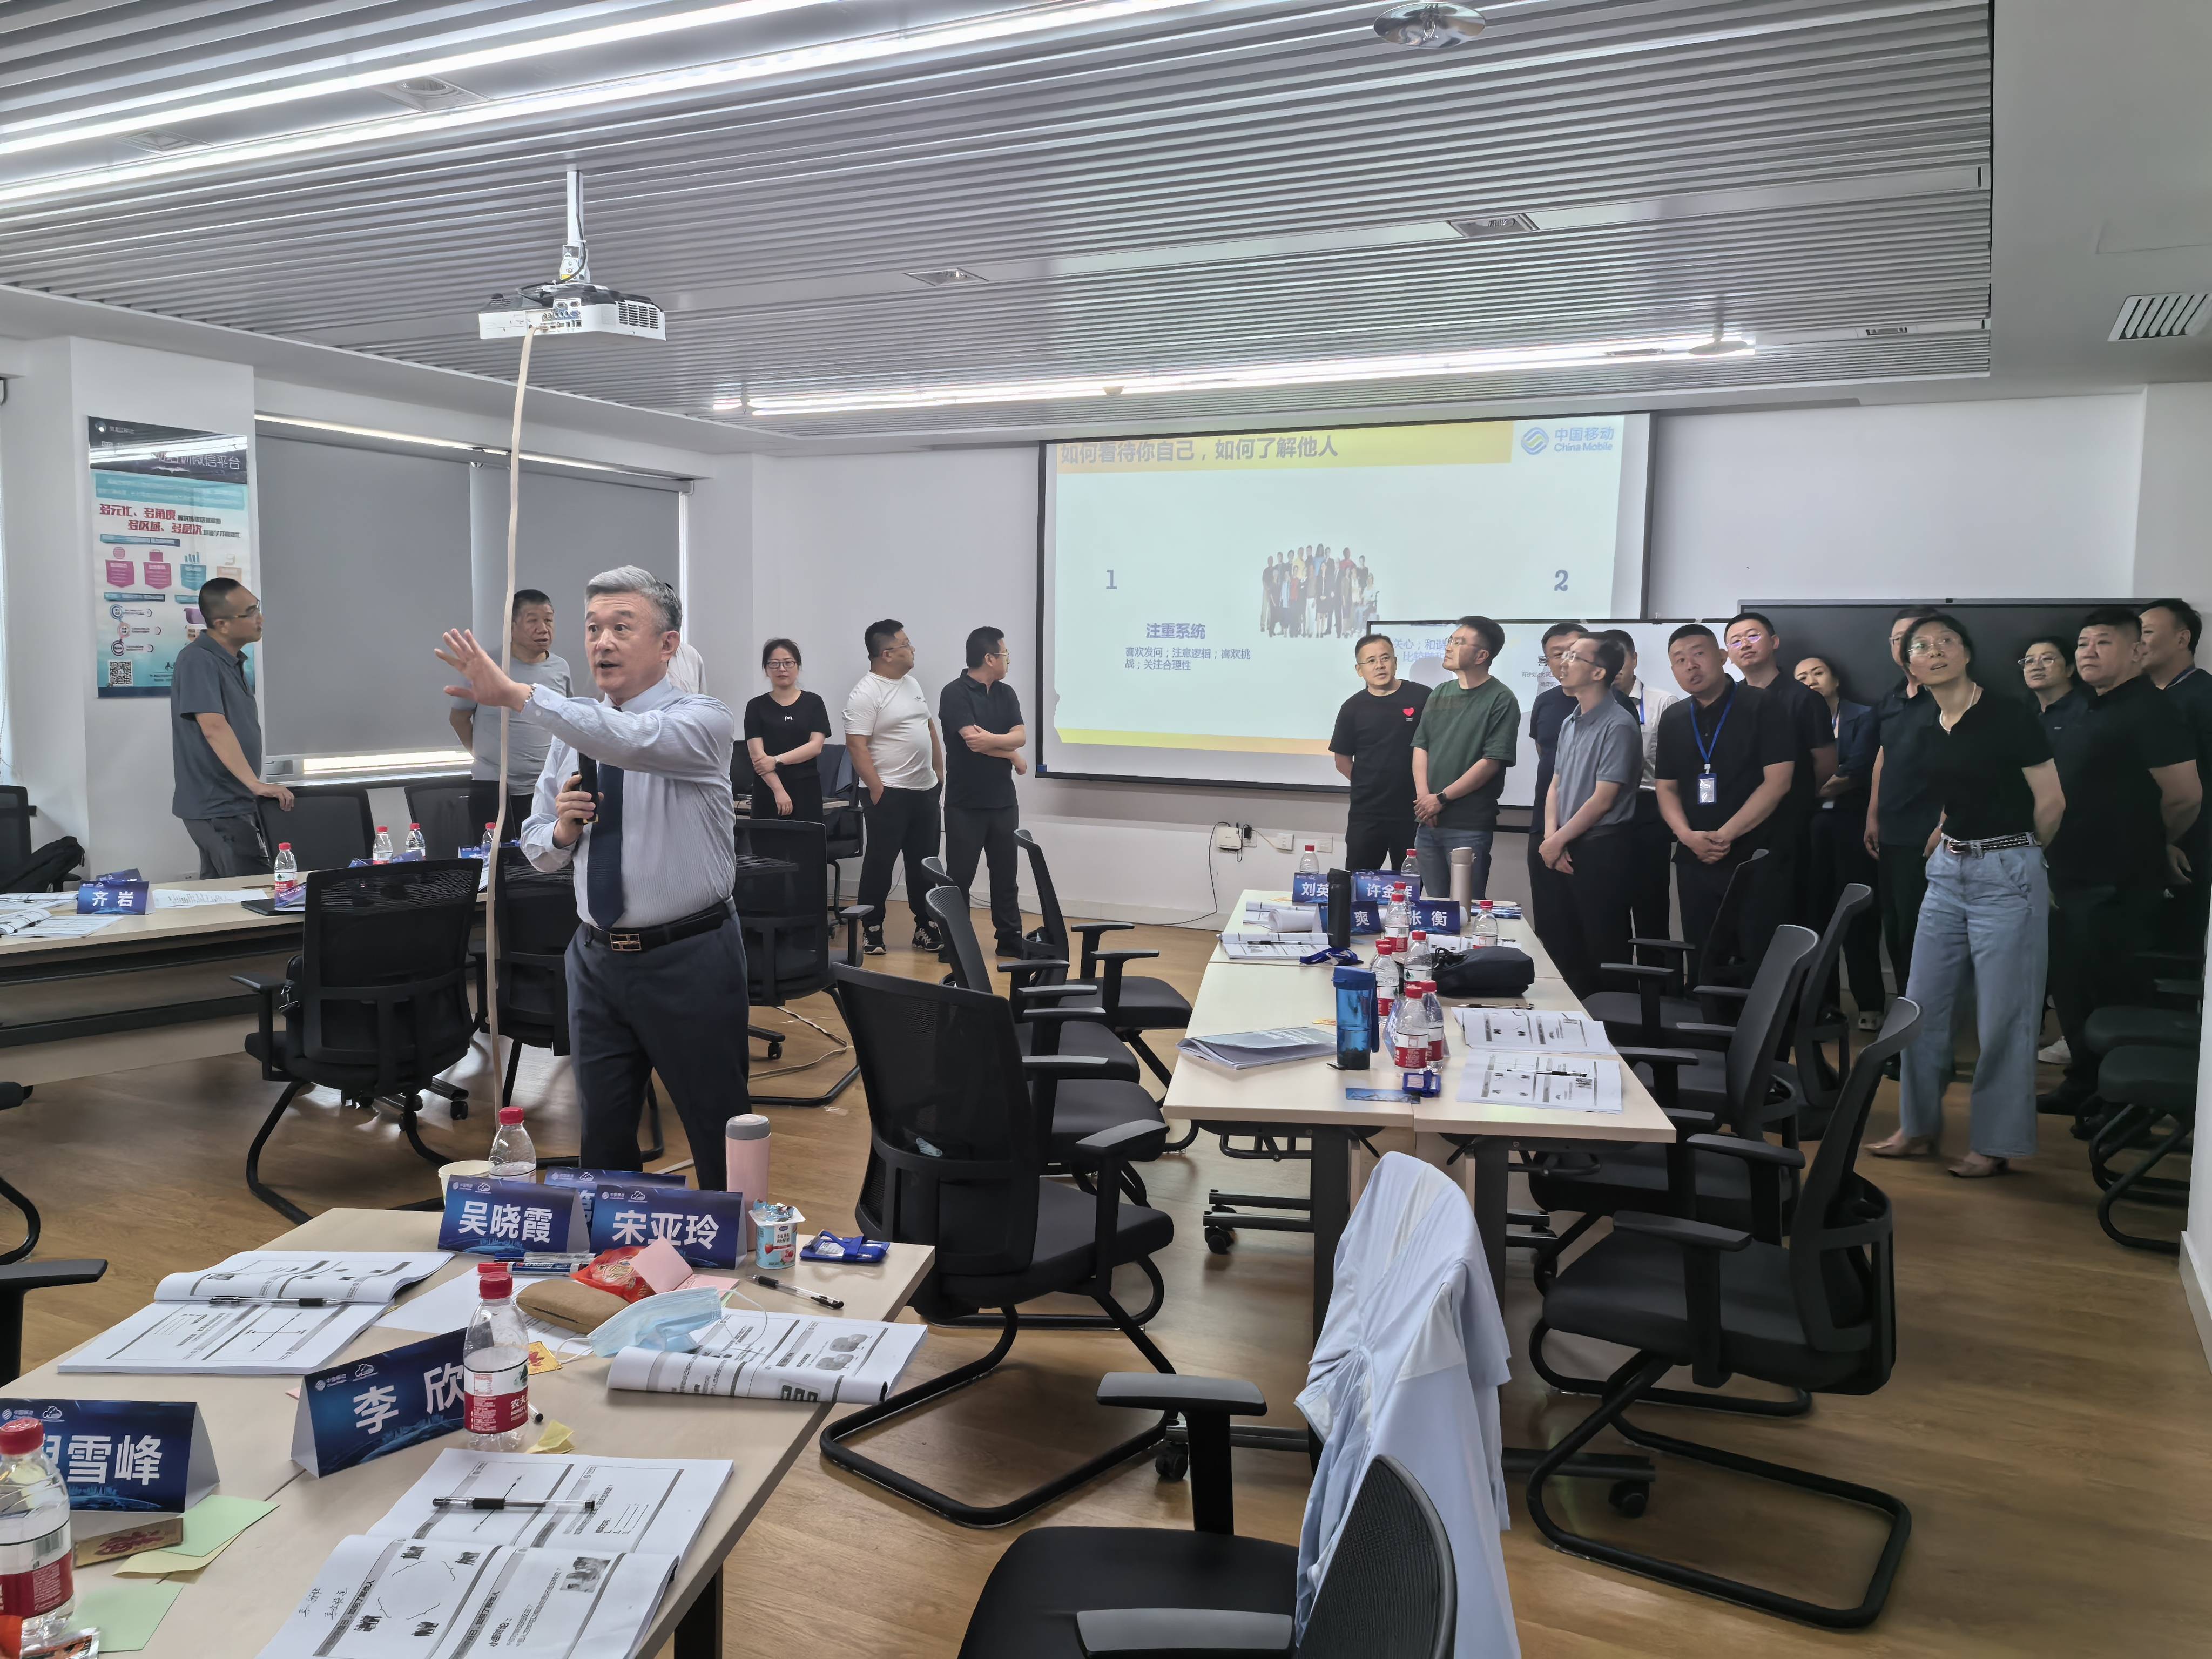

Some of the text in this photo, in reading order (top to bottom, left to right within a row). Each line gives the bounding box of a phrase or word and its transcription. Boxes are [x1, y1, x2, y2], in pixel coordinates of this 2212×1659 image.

[1555, 426, 1615, 442] 中国移动
[1061, 435, 1338, 464] 如何看待你自己，如何了解他人
[1554, 442, 1613, 452] China Mobile
[1105, 569, 1117, 590] 1
[1554, 570, 1569, 592] 2
[1145, 623, 1206, 639] 注重系统
[1125, 647, 1251, 660] 喜欢发问；注意逻辑；喜欢挑
[1125, 659, 1191, 671] 战；关注合理性
[92, 891, 133, 907] 齐 岩
[1354, 911, 1370, 926] 爽
[1431, 911, 1447, 926] 衡
[458, 1201, 552, 1243] 吴晓霞
[612, 1209, 719, 1250] 宋亚玲
[353, 1385, 399, 1435] 李
[423, 1363, 464, 1414] 欣
